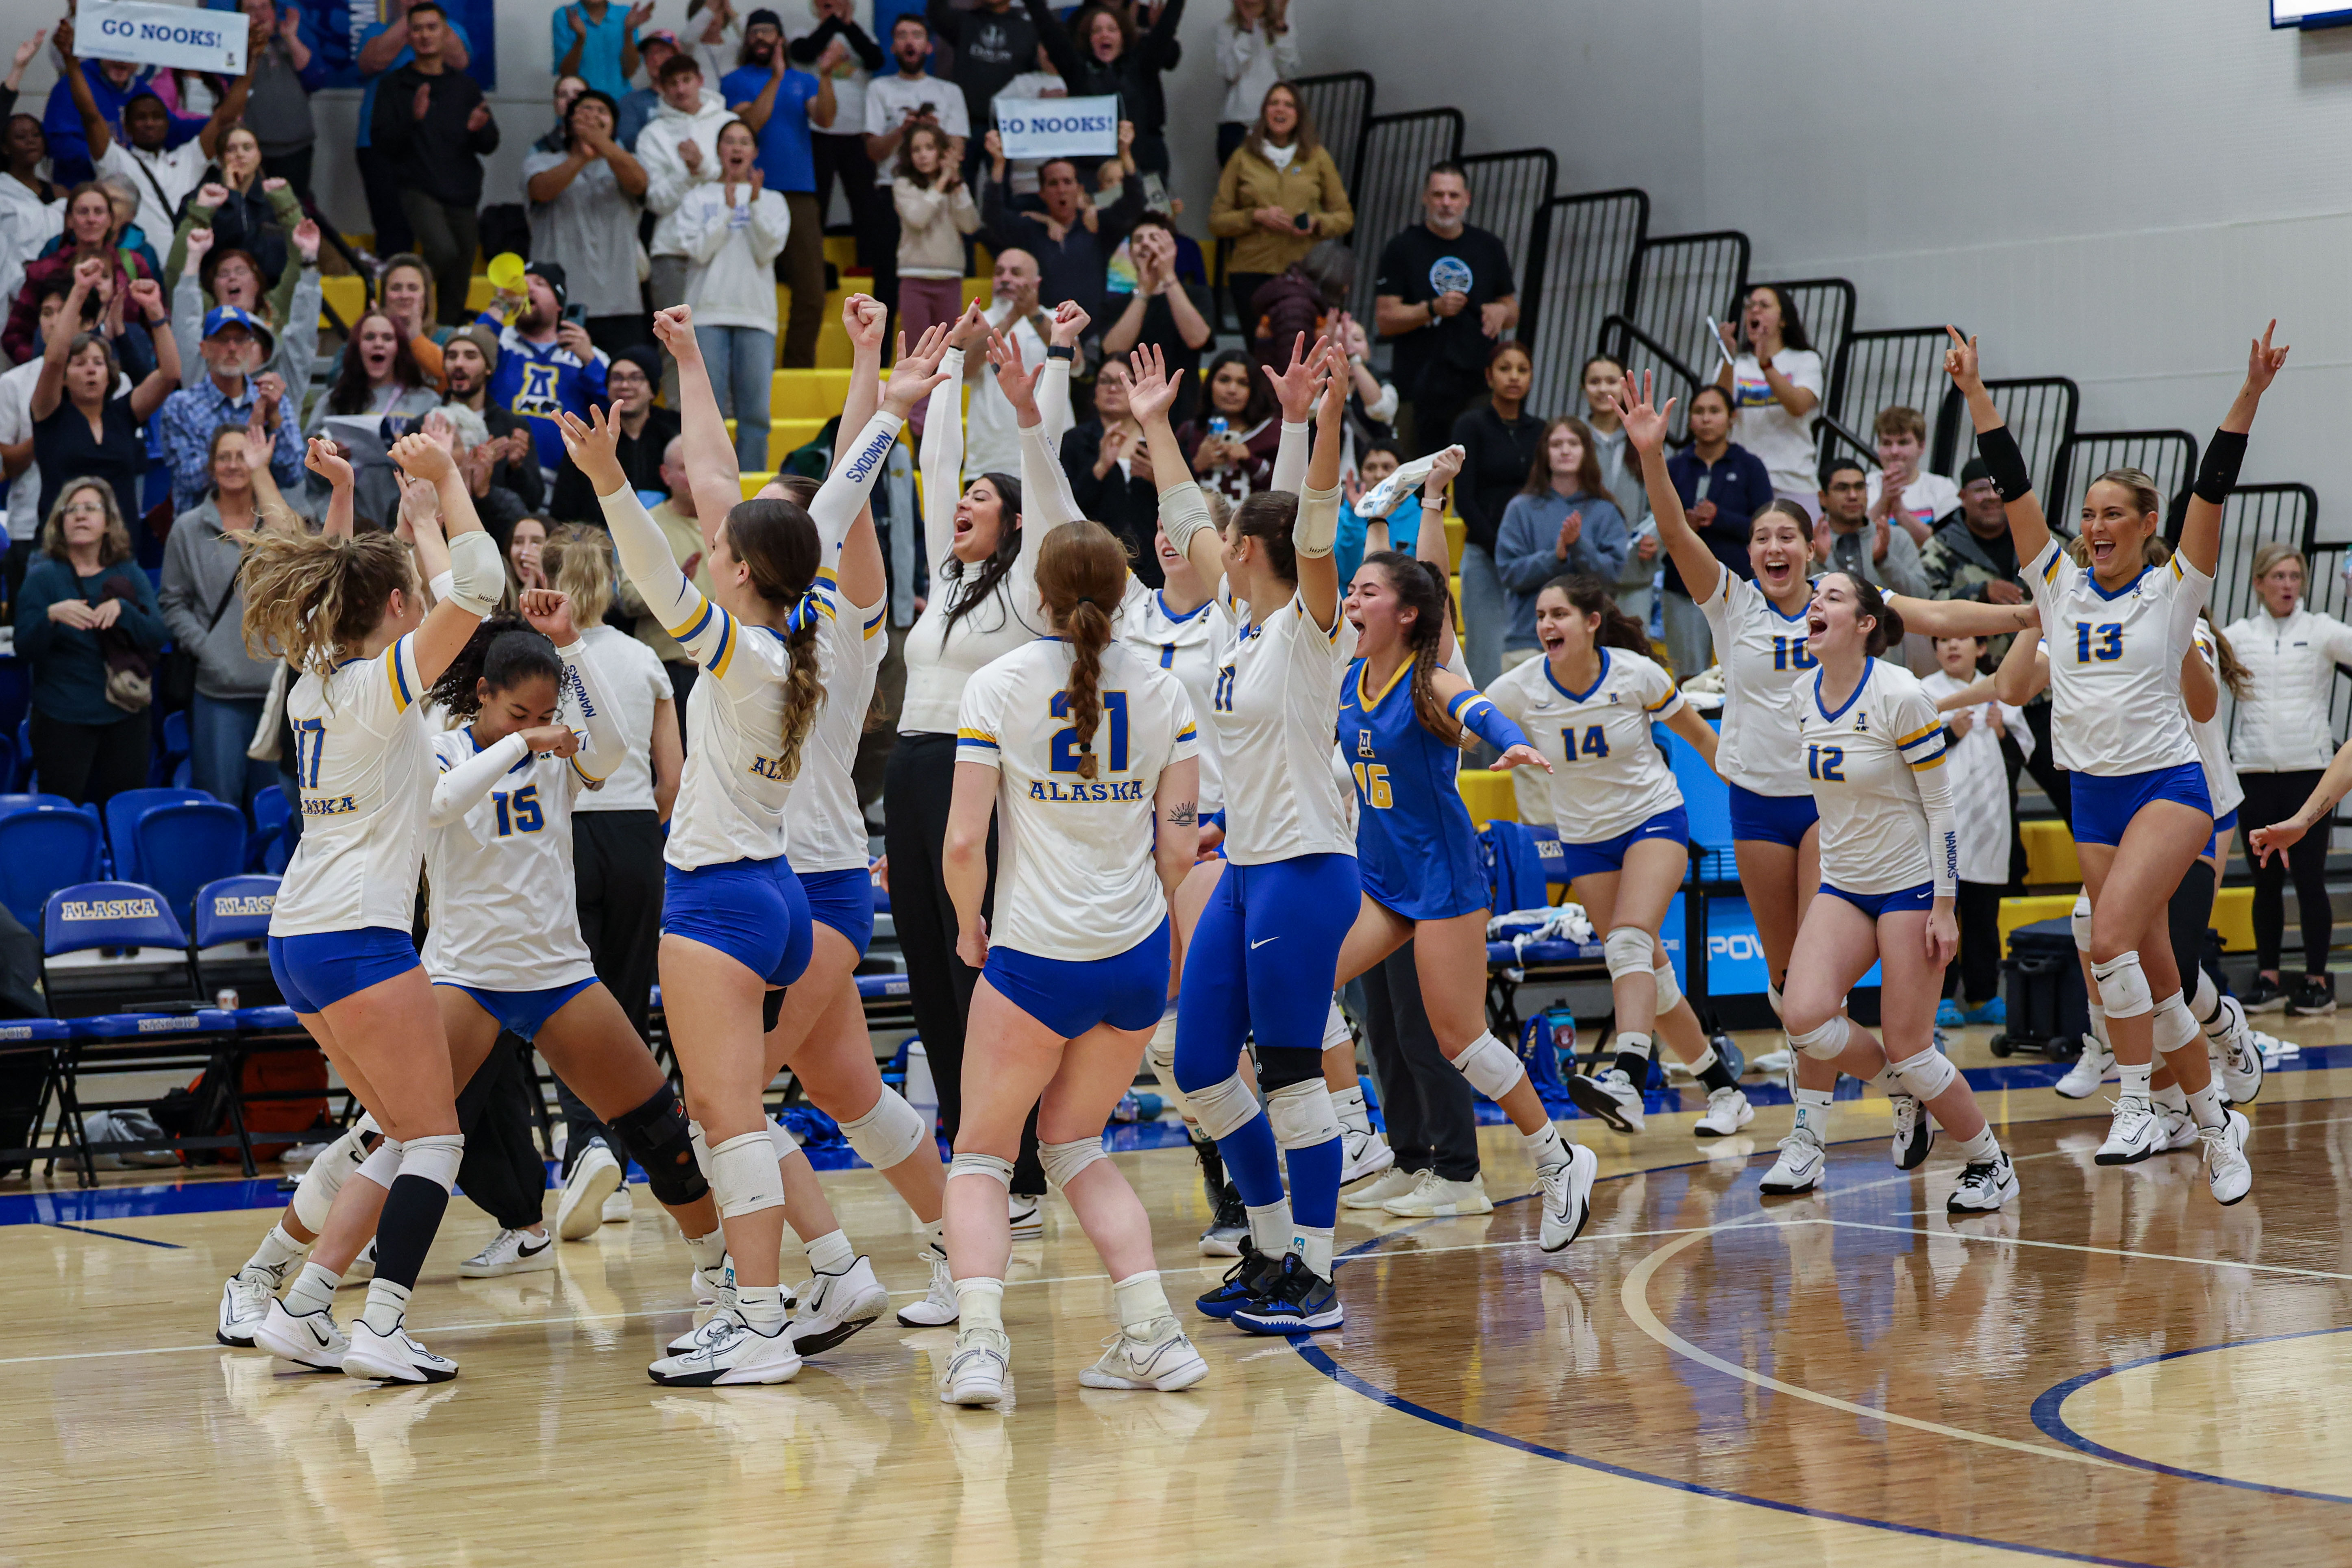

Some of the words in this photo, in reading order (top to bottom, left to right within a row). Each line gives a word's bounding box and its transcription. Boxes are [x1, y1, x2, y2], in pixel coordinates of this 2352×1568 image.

[102, 19, 134, 37] GO
[141, 23, 222, 48] NOOKS!
[1031, 116, 1113, 134] NOOKS!
[846, 430, 892, 483] NANOOKS
[1772, 635, 1819, 671] 10
[2076, 621, 2124, 663] 13
[568, 664, 596, 718] NANOOKS
[1048, 689, 1130, 774] 21
[1561, 724, 1610, 761] 14
[294, 716, 327, 790] 17
[1808, 743, 1846, 783] 12
[1029, 779, 1144, 803] ALASKA
[1352, 762, 1393, 809] 16
[491, 783, 546, 838] 15
[1944, 831, 1957, 879] NANOOKS
[62, 898, 159, 921] ALASKA
[215, 896, 277, 916] ALAS
